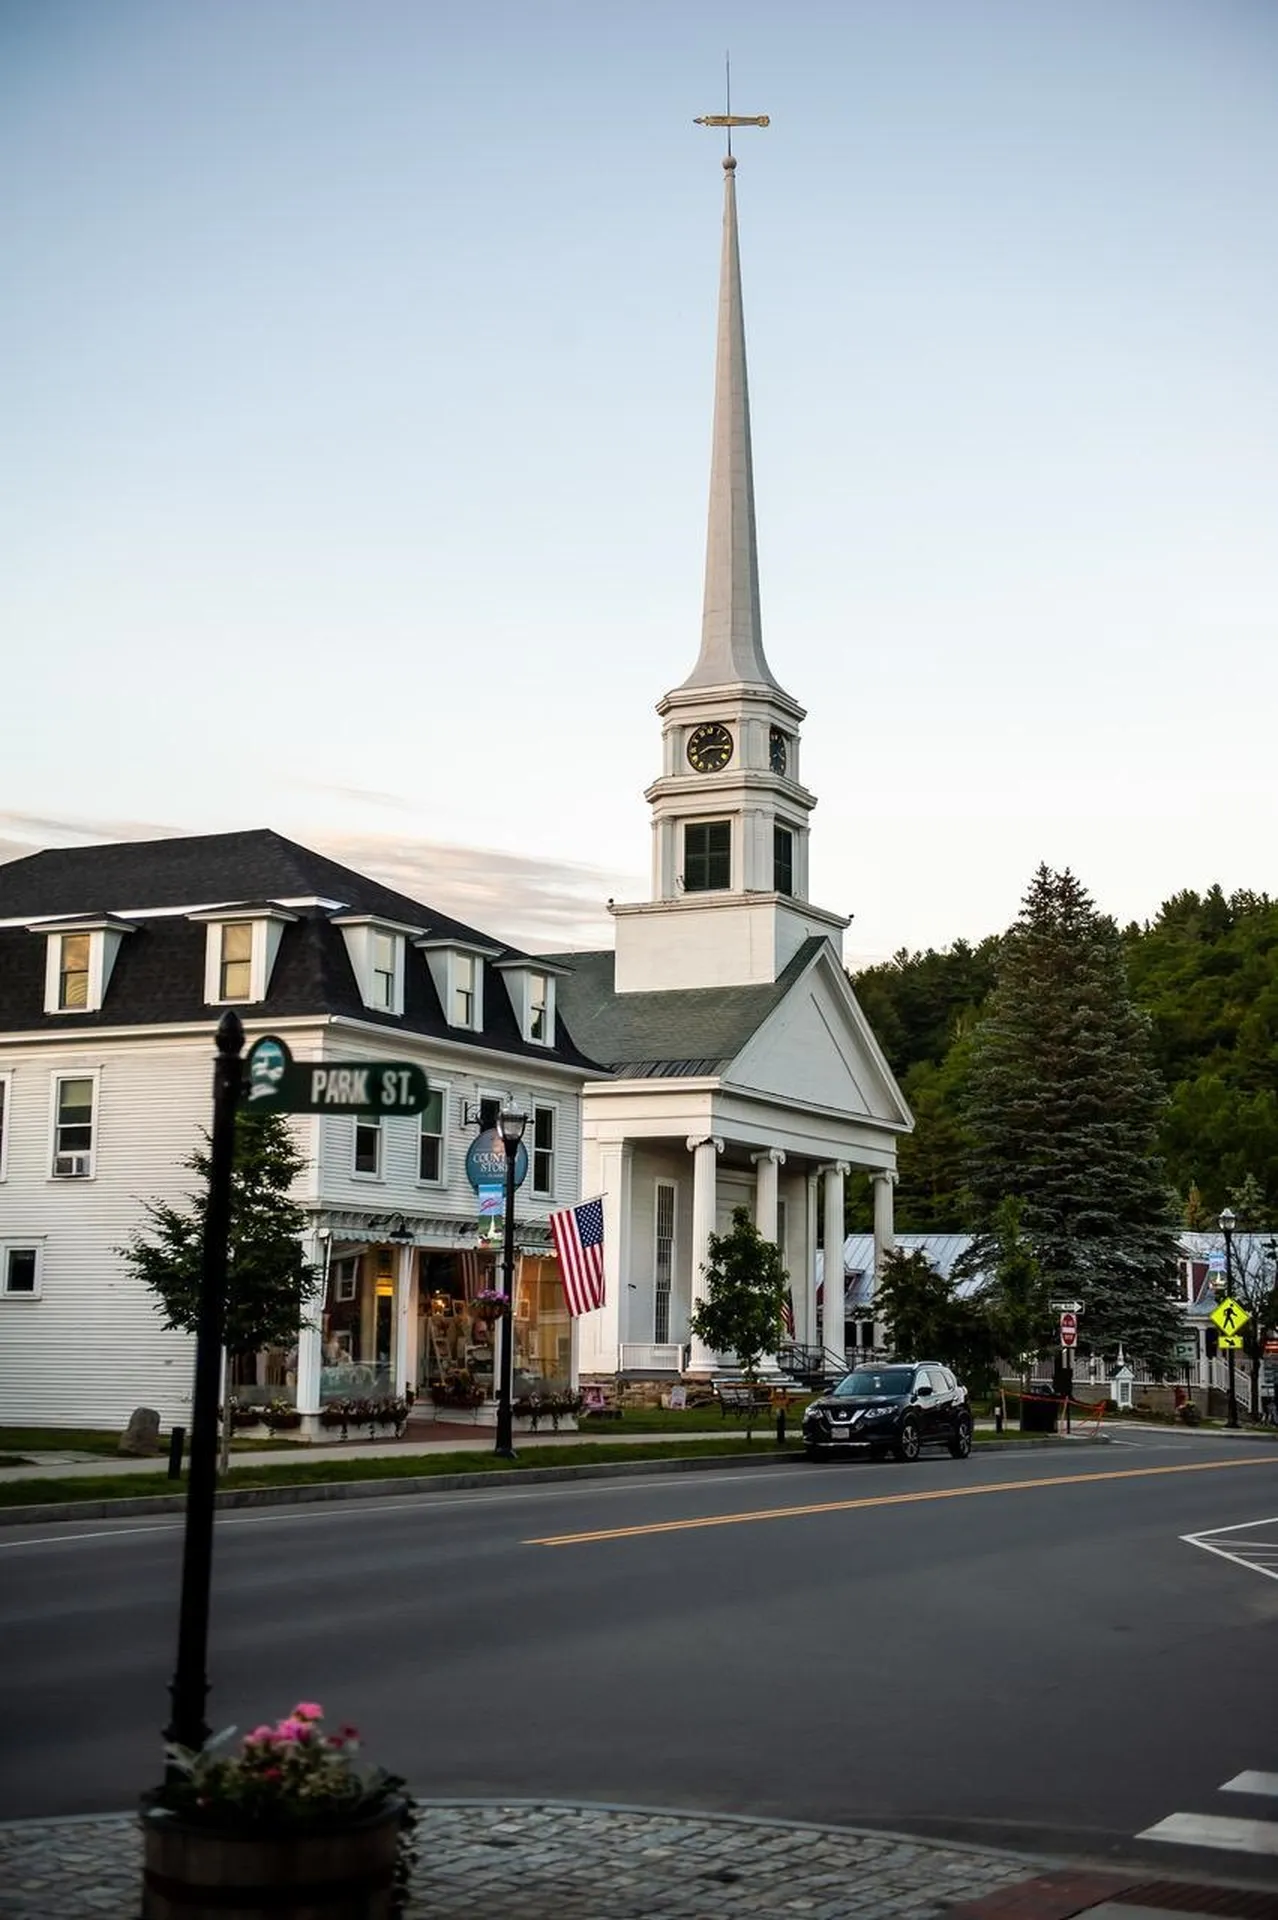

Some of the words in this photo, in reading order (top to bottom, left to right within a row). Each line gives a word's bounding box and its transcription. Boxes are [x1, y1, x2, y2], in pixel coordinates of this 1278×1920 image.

[310, 1069, 370, 1104] PARK
[381, 1070, 416, 1105] ST.
[473, 1152, 519, 1164] COUNT
[480, 1163, 508, 1173] STOR
